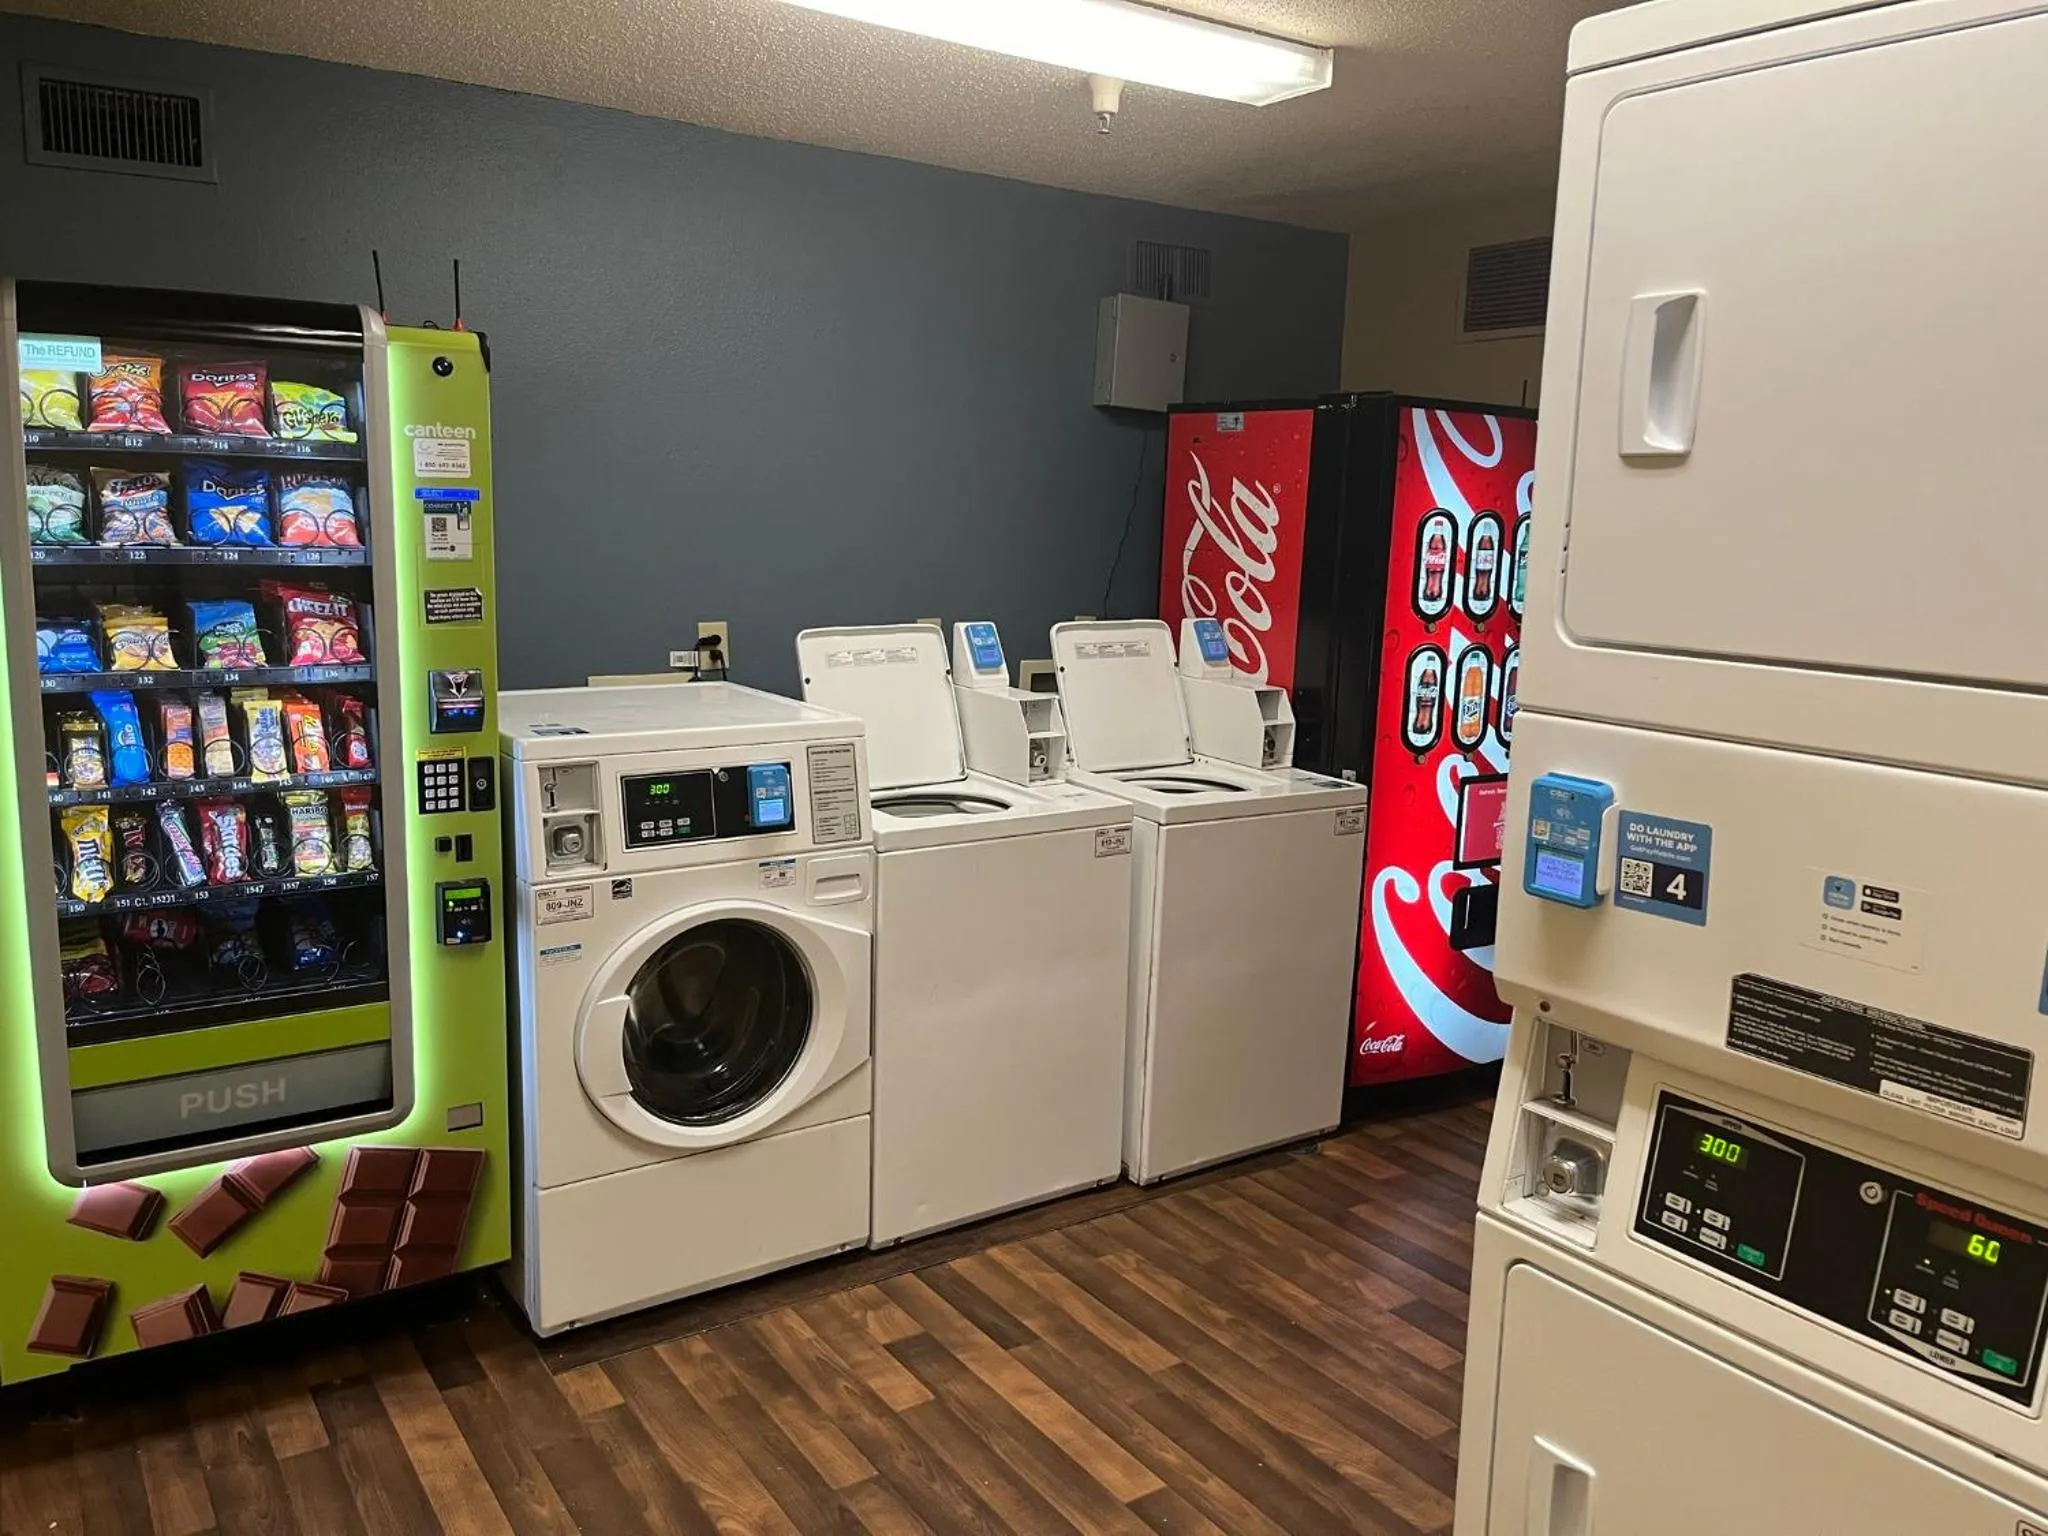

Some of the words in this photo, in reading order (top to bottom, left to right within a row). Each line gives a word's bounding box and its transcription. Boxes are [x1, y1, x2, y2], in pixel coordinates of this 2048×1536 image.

[24, 343, 46, 356] The
[46, 344, 96, 358] REFUND
[191, 372, 257, 387] Doritos
[404, 422, 477, 439] canteen
[202, 479, 266, 500] Doritos
[290, 806, 328, 816] HARIBO
[1626, 831, 1654, 844] WITH
[1655, 837, 1675, 849] THE
[1676, 842, 1698, 854] APP
[1629, 822, 1645, 833] DO
[1646, 825, 1696, 842] LAUNDRY
[1666, 872, 1688, 901] 4
[1360, 1034, 1406, 1055] Coca-Cola
[180, 1077, 287, 1120] PUSH
[1700, 1133, 1741, 1164] 300
[1915, 1192, 1974, 1222] Speed
[1974, 1212, 2033, 1245] Queen
[1967, 1233, 2002, 1264] 60
